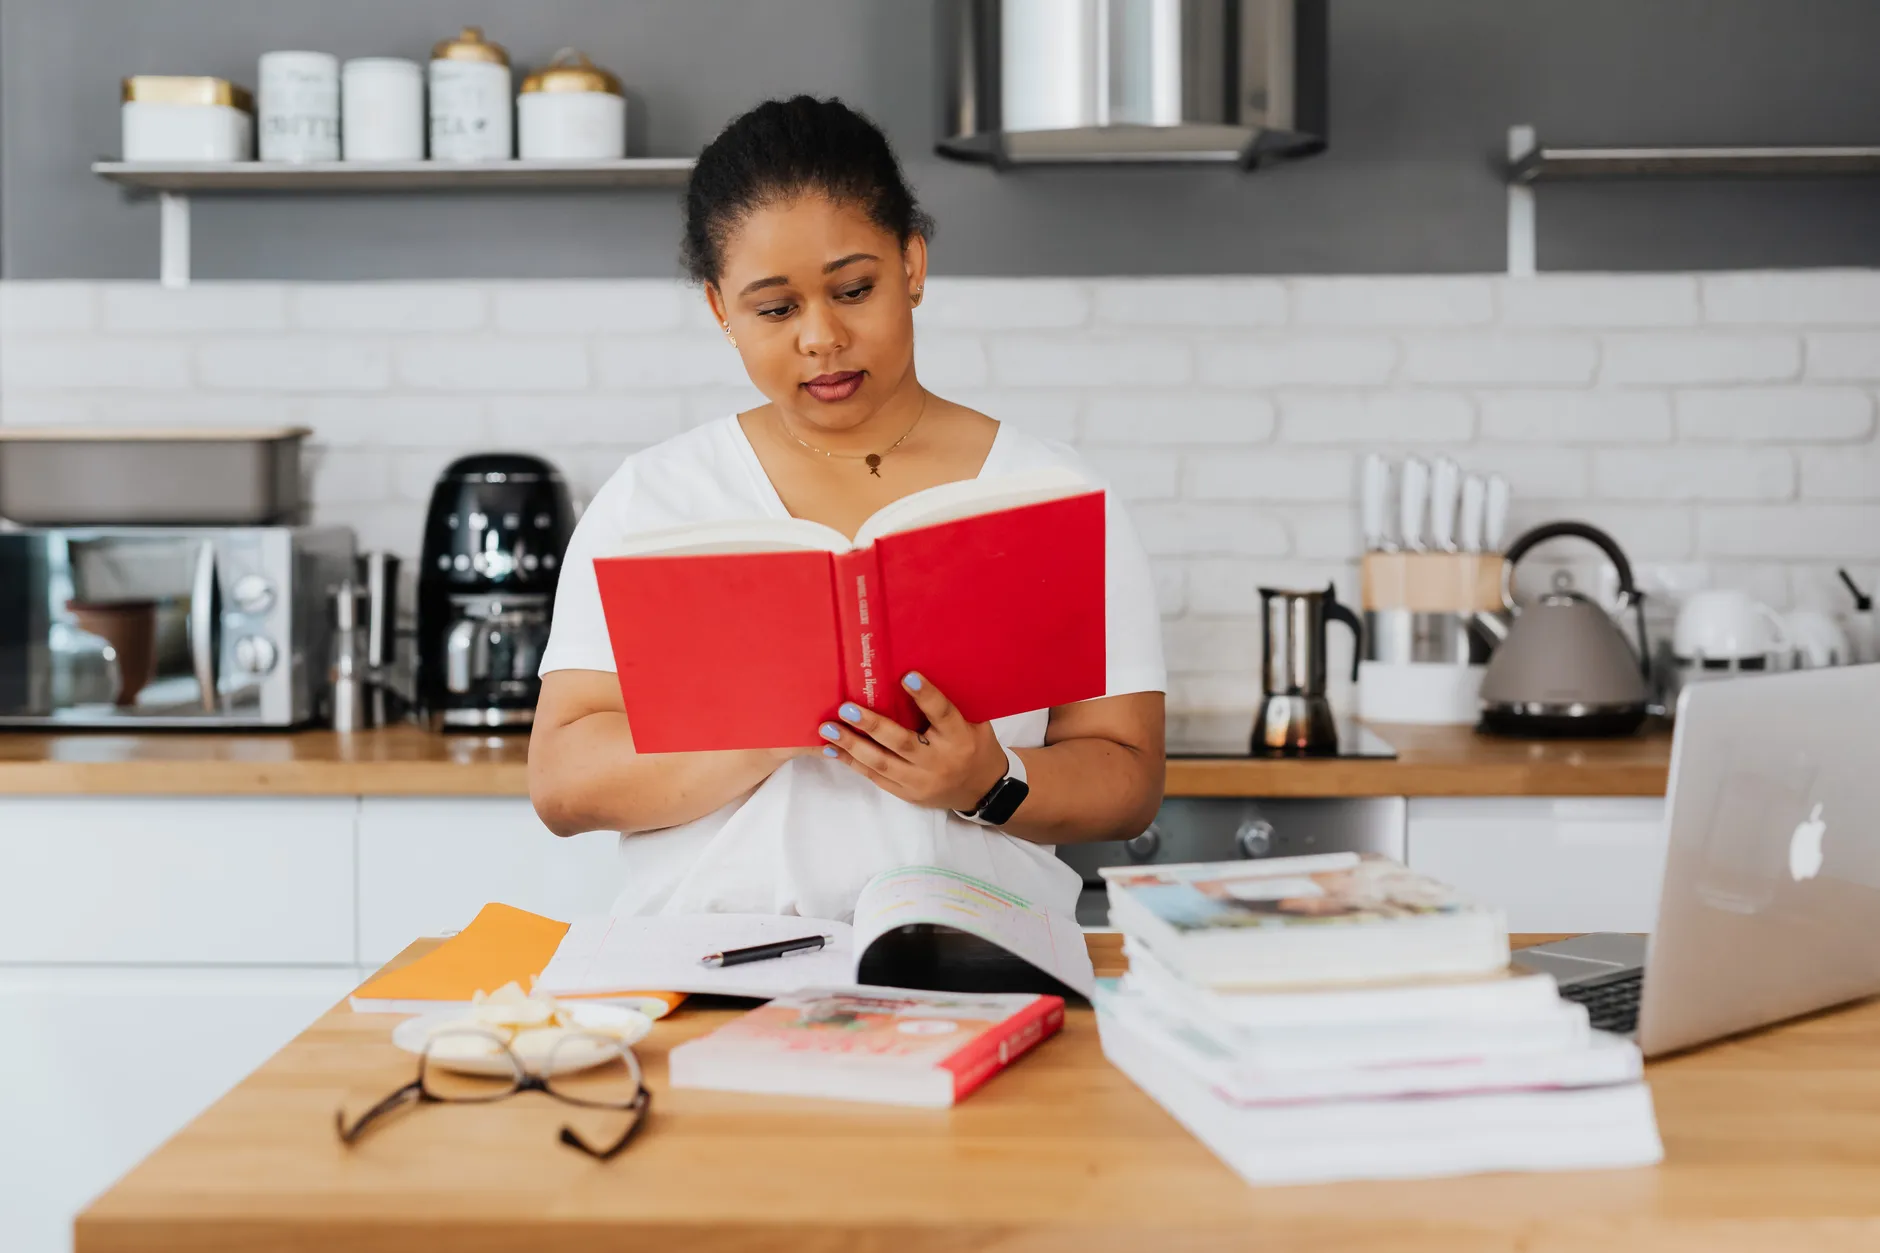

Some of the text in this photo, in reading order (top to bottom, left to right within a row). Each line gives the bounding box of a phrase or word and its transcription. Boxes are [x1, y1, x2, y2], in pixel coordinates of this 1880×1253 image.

[860, 632, 877, 708] Stumbling on Happines
